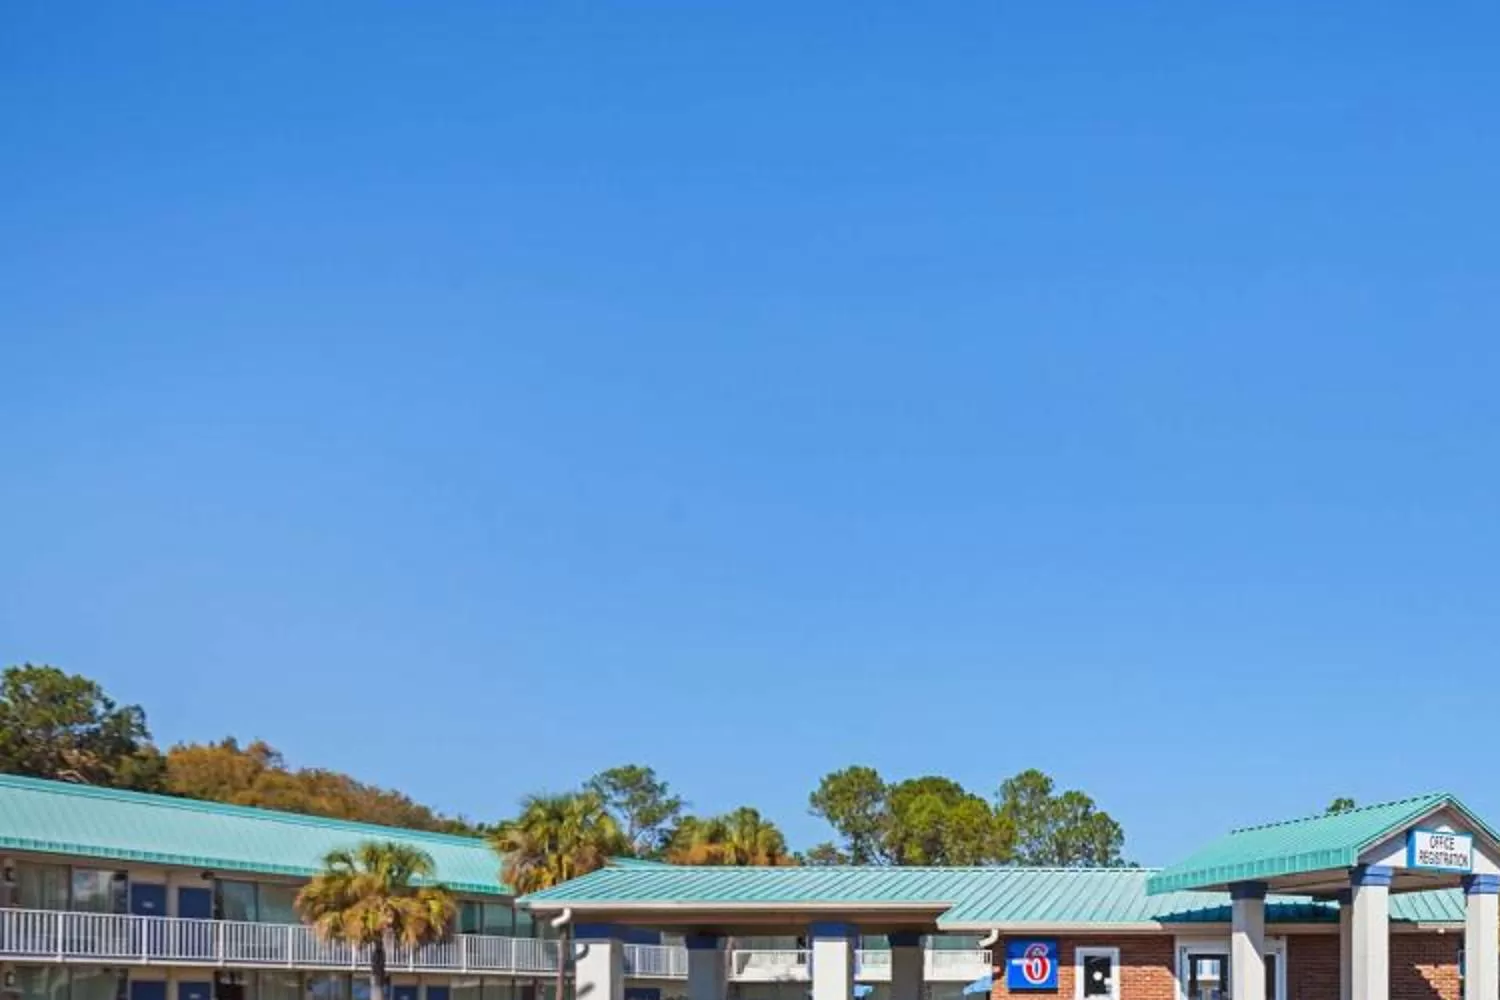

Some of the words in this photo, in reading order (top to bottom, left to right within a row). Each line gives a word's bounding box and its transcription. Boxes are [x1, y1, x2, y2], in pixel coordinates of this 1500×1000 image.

[1430, 834, 1455, 851] OFFICE
[1418, 849, 1469, 867] REGISTRATION
[1023, 942, 1051, 985] 6
